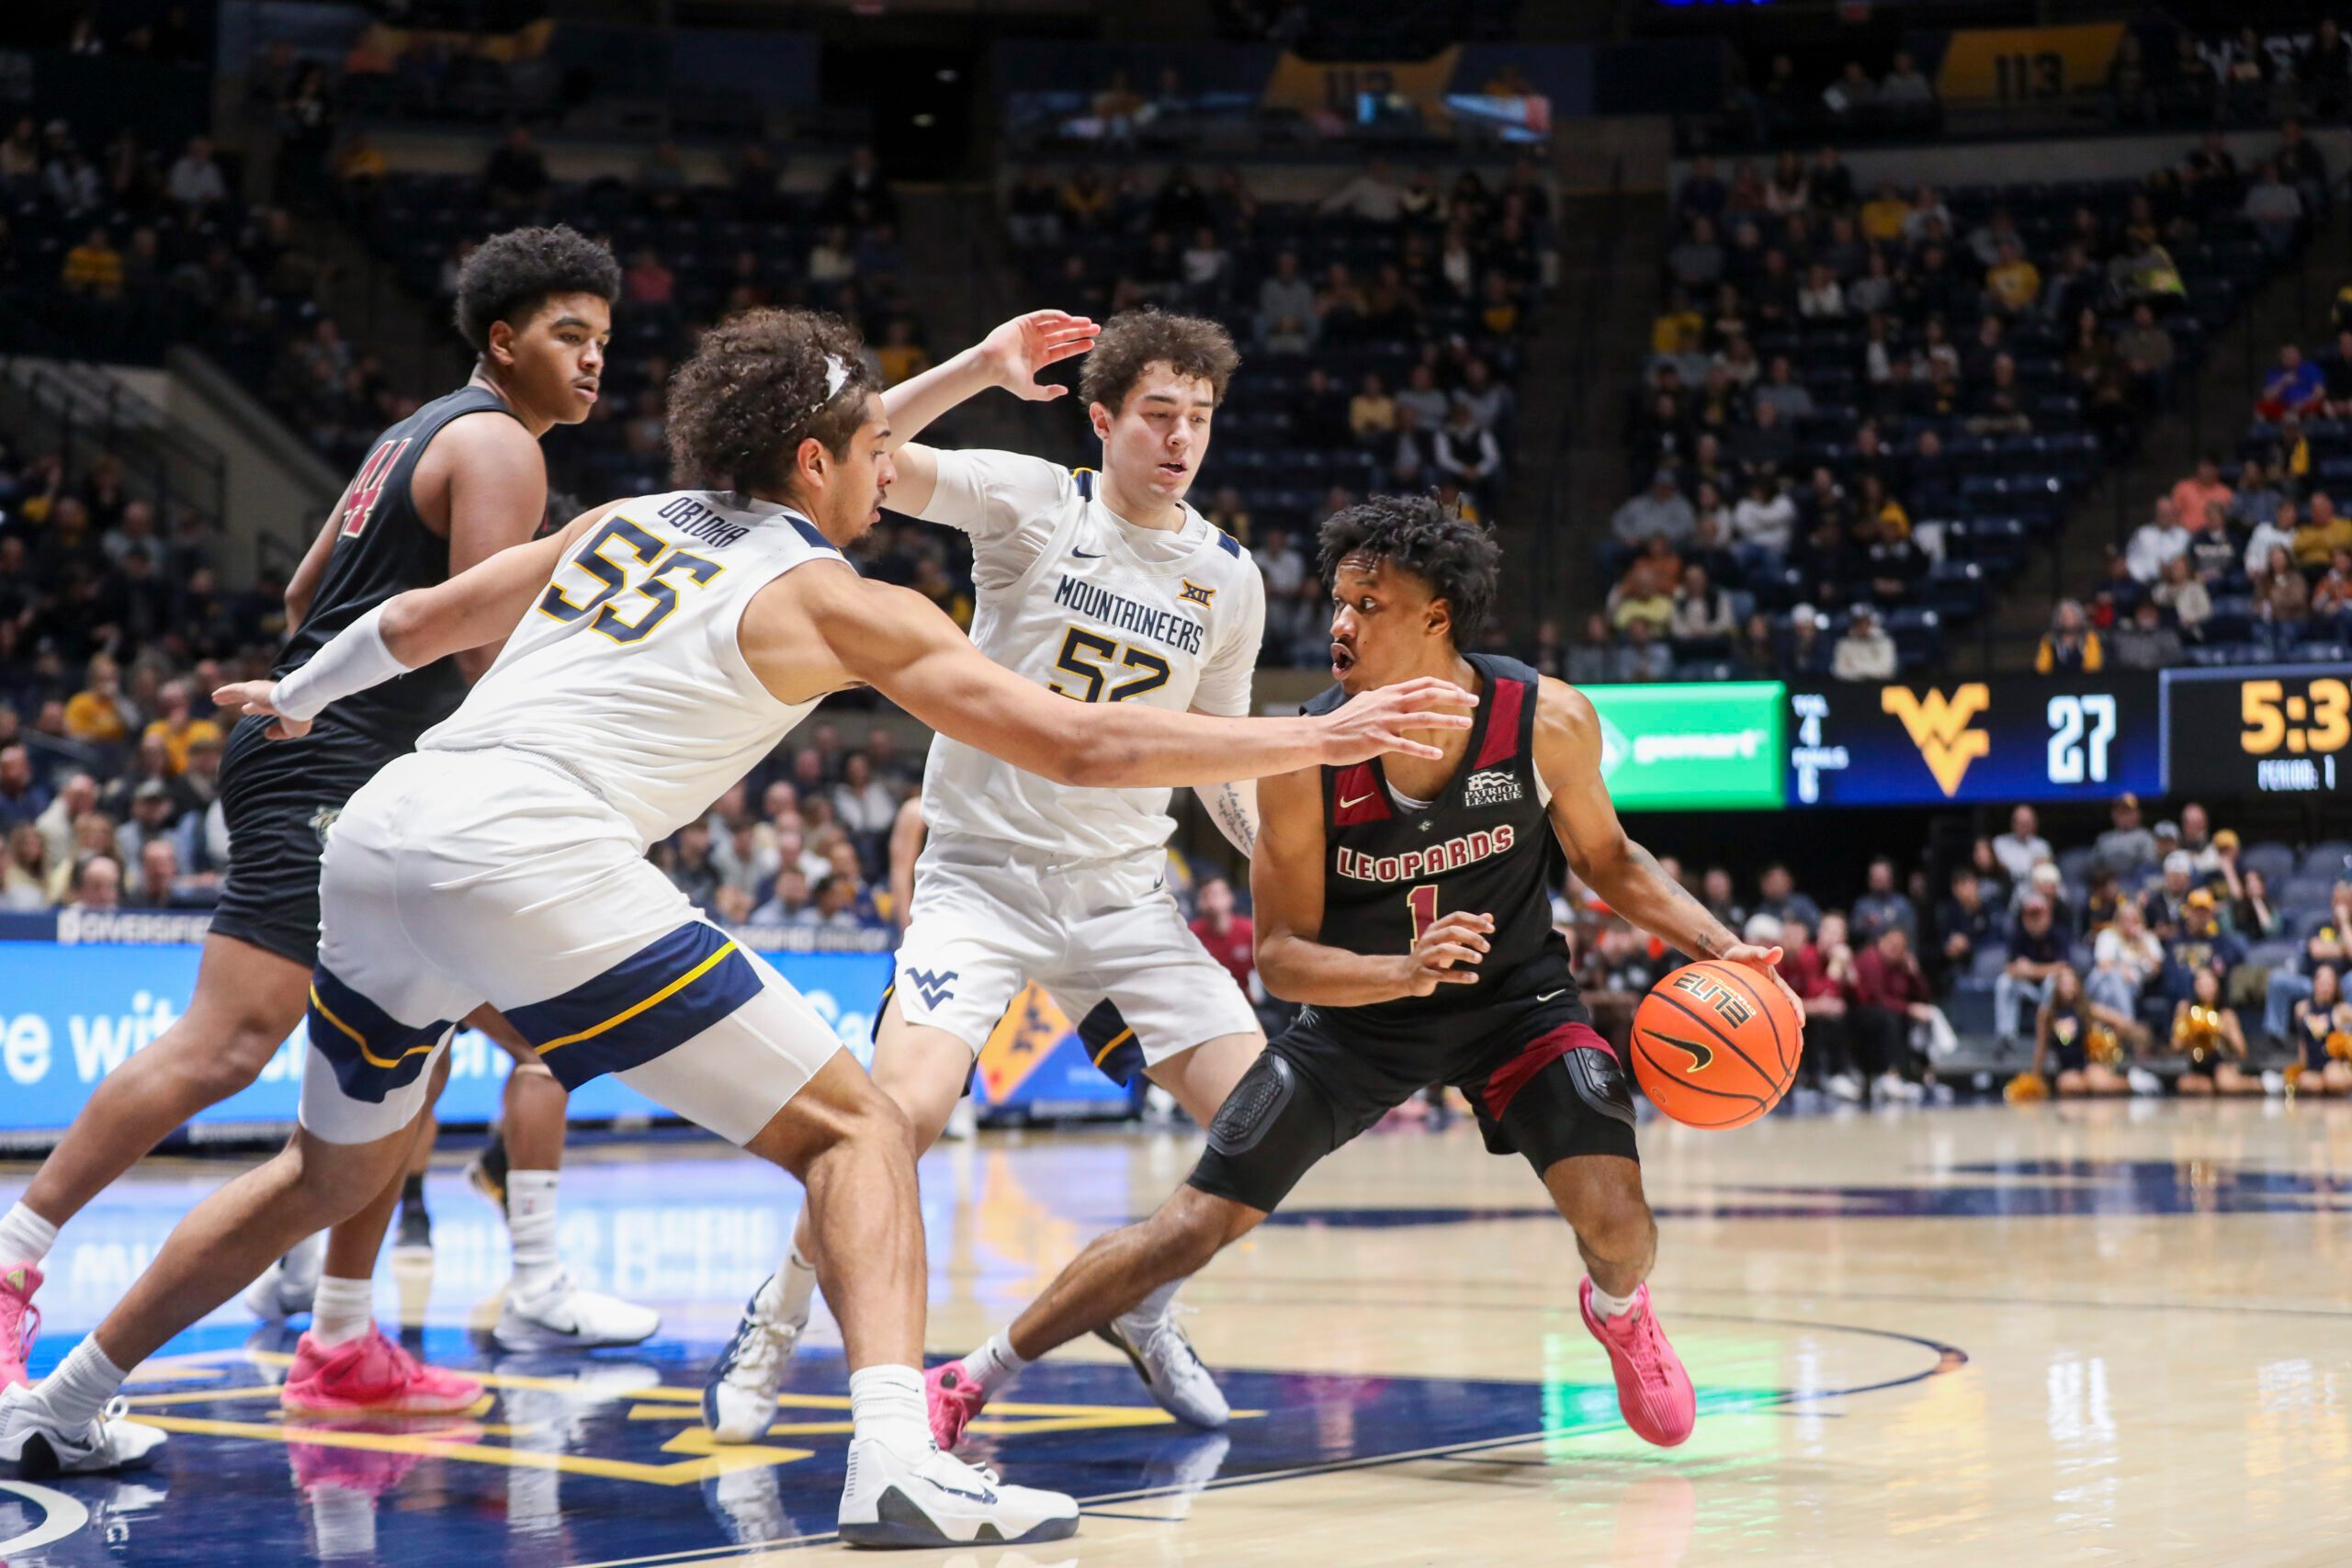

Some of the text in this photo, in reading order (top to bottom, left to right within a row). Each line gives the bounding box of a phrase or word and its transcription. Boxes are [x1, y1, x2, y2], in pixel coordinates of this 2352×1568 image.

[537, 513, 726, 645] 55
[1054, 574, 1204, 656] MOUNTAINEERS
[1049, 626, 1170, 703] 52
[2047, 694, 2116, 784] 27
[2240, 678, 2352, 755] 5:3
[1465, 784, 1521, 798] PATRIOT
[1465, 791, 1522, 807] LEAGUE
[1337, 824, 1515, 883] LEOPARDS
[1407, 885, 1439, 955] 1
[1672, 971, 1751, 1030] ELITE
[0, 1013, 52, 1085] e
